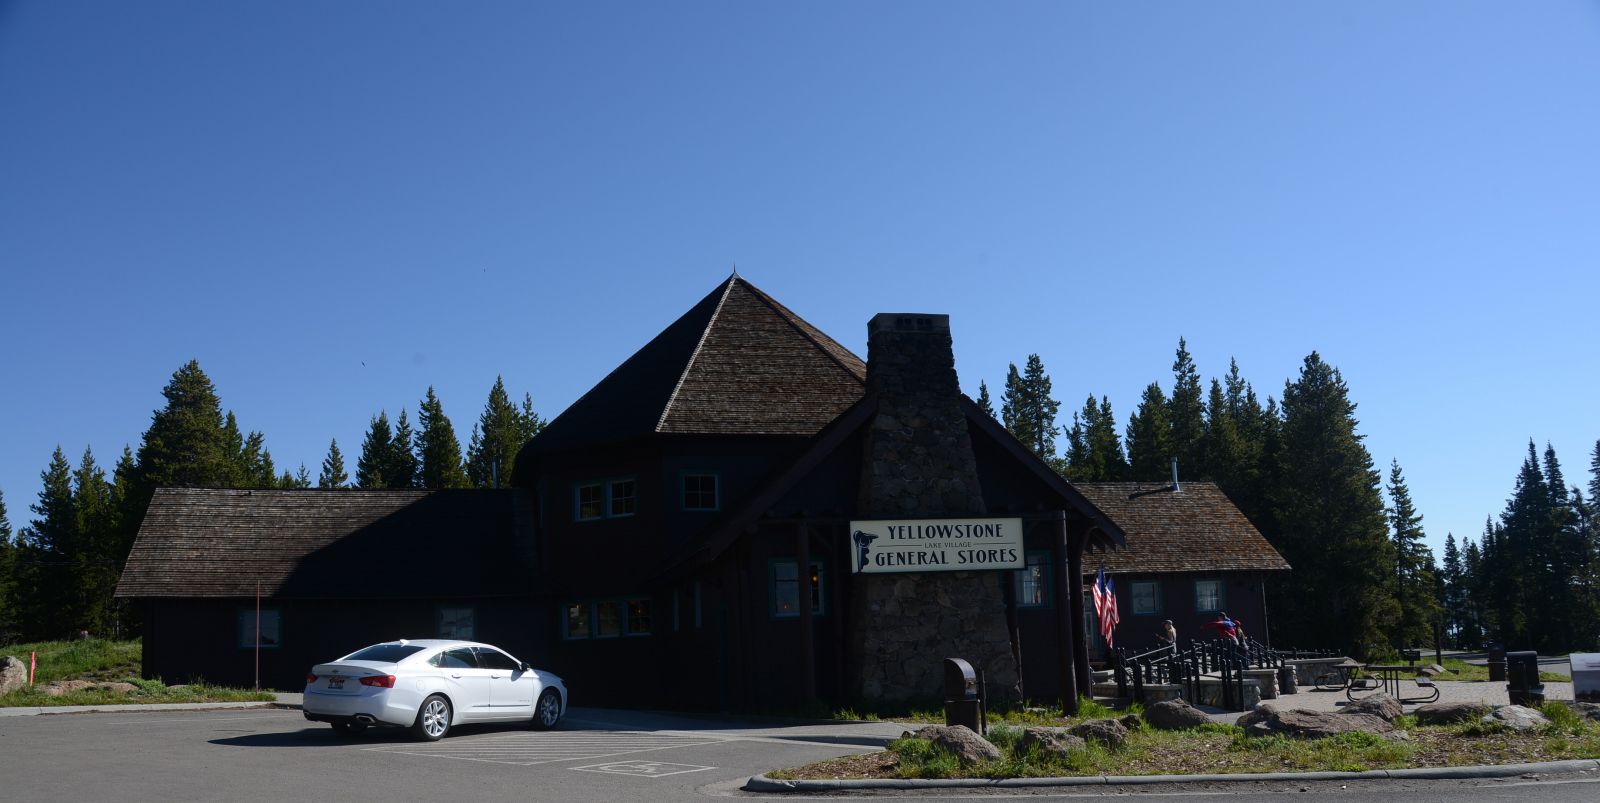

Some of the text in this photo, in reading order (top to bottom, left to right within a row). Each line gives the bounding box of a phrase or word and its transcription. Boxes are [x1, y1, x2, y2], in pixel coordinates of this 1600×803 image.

[888, 524, 1003, 539] YELLOWSTONE
[875, 549, 1017, 566] GENERAL STORES
